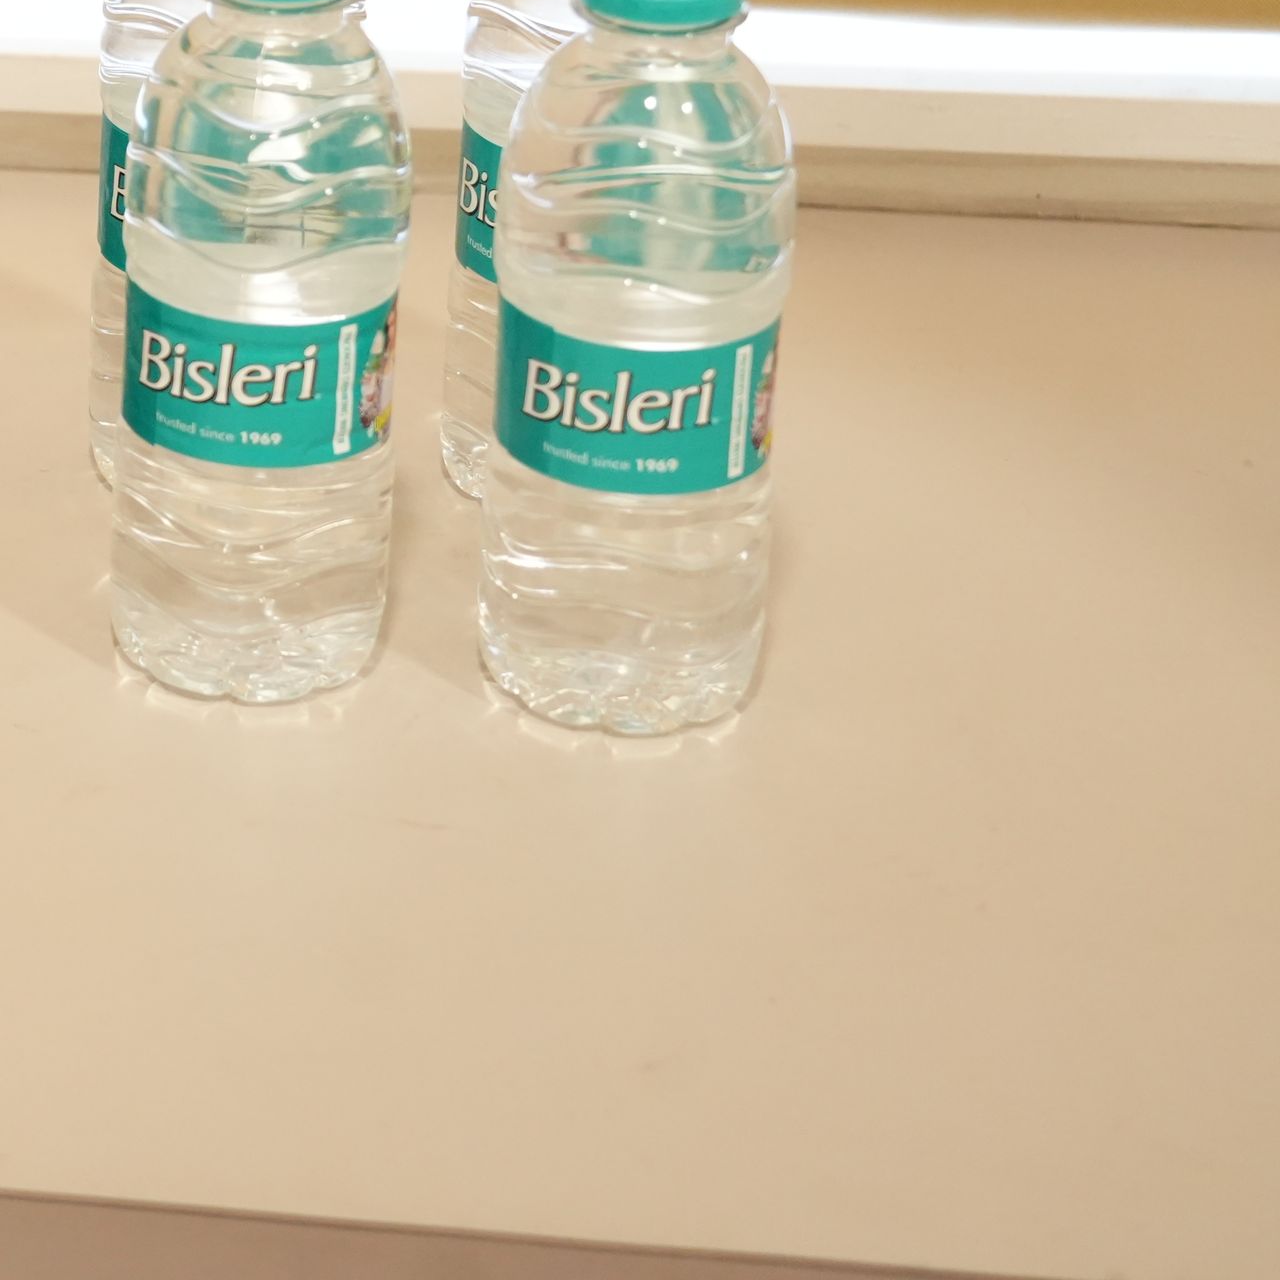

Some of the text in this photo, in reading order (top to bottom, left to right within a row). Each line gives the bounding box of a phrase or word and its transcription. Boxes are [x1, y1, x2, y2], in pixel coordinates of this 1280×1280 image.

[138, 328, 319, 407] Bisleri
[520, 357, 718, 434] Bisleri
[199, 426, 236, 443] since
[240, 430, 283, 446] 1969
[635, 457, 679, 474] 1969
